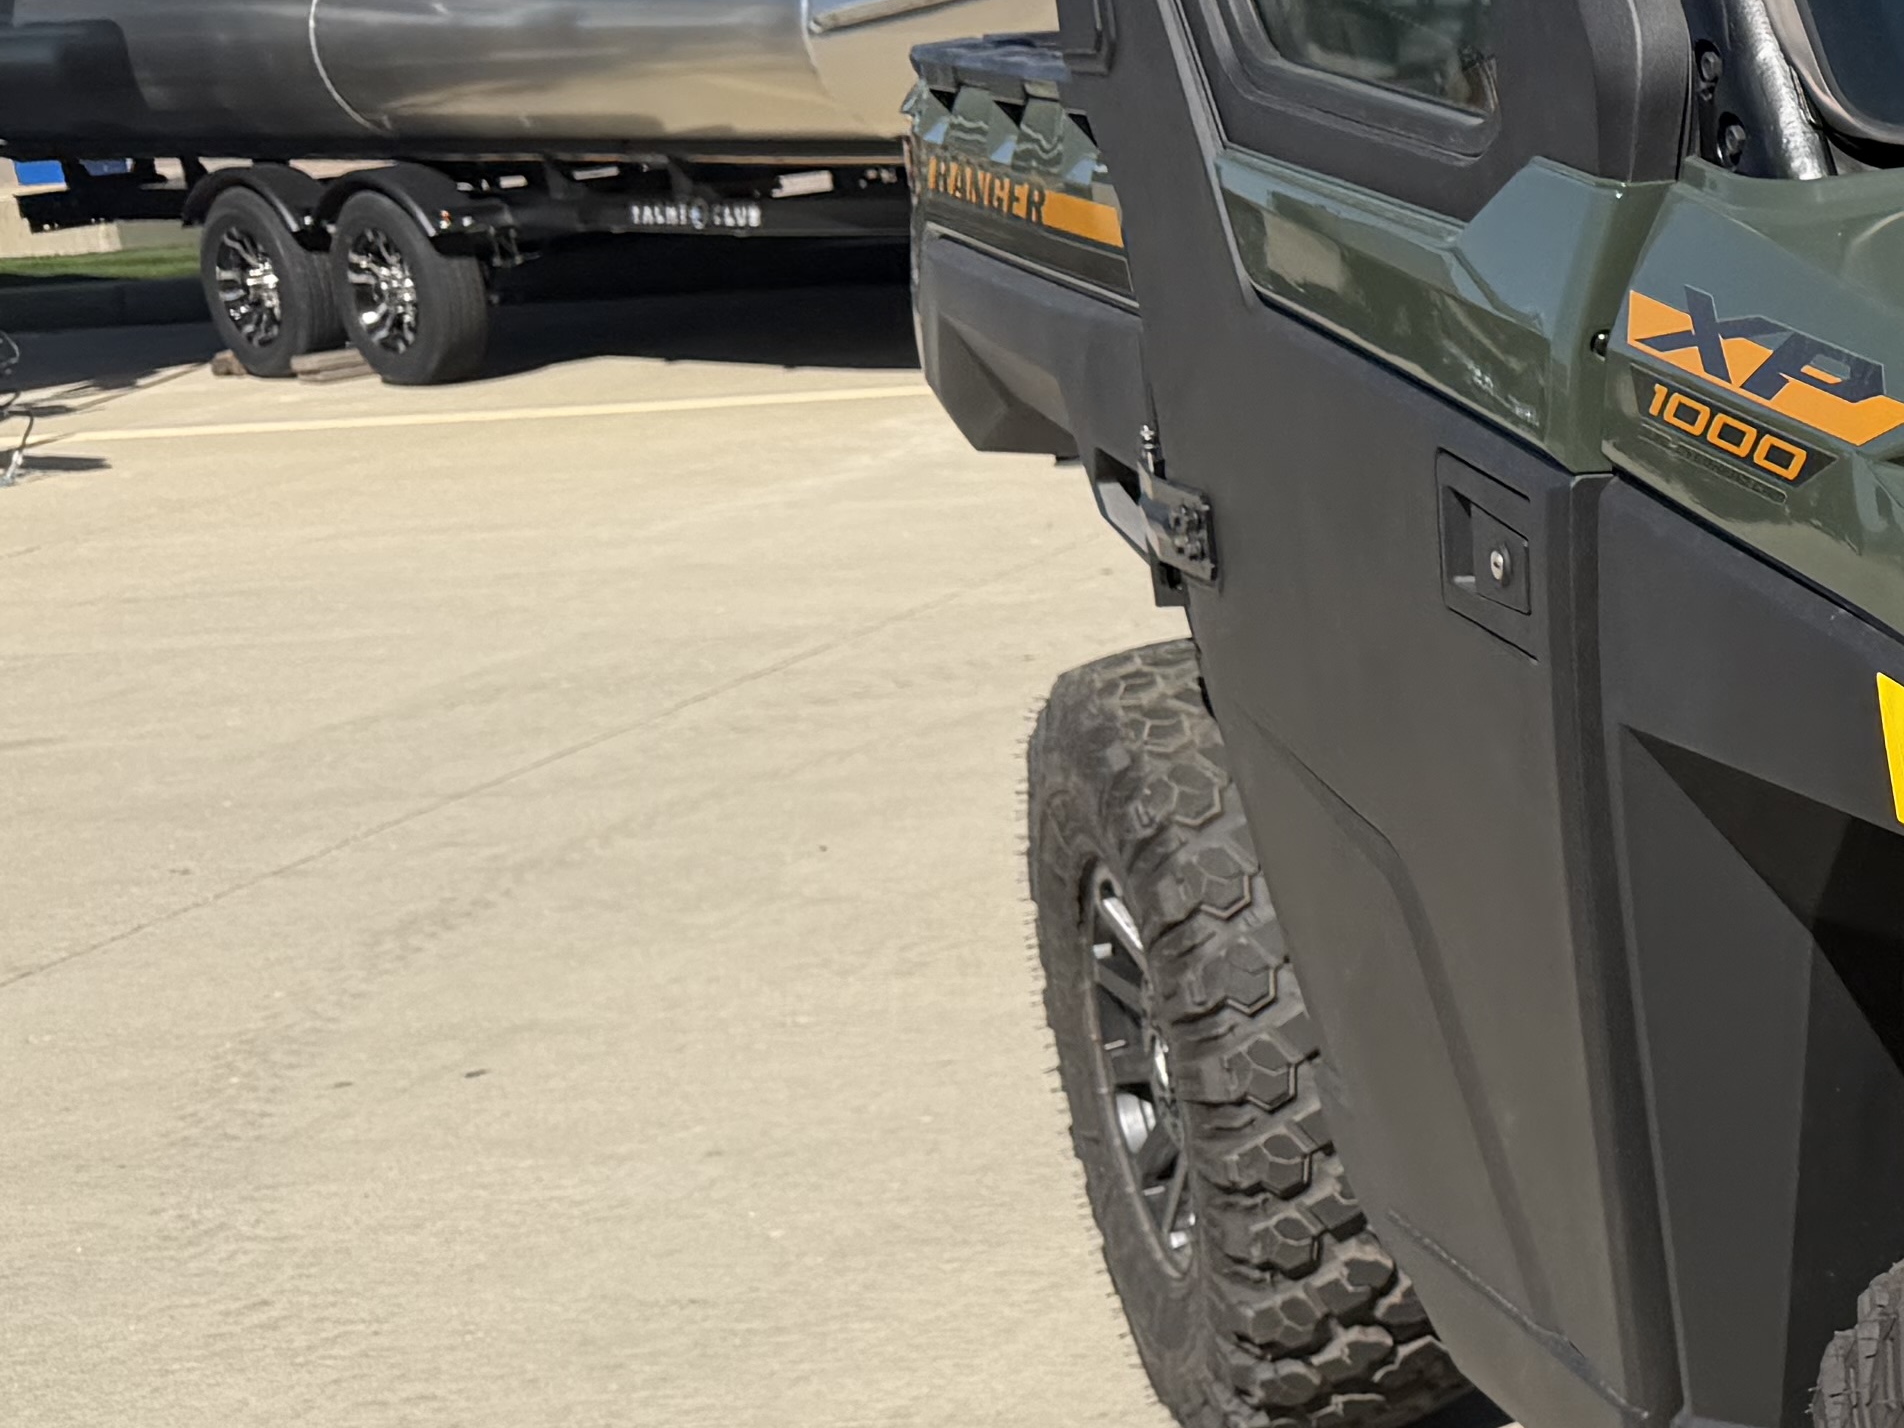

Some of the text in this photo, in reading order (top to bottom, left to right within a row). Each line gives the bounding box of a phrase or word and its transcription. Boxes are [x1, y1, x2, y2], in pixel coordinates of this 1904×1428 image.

[934, 155, 1047, 225] RANGER
[1633, 283, 1887, 403] XP
[1648, 382, 1808, 481] 1000
